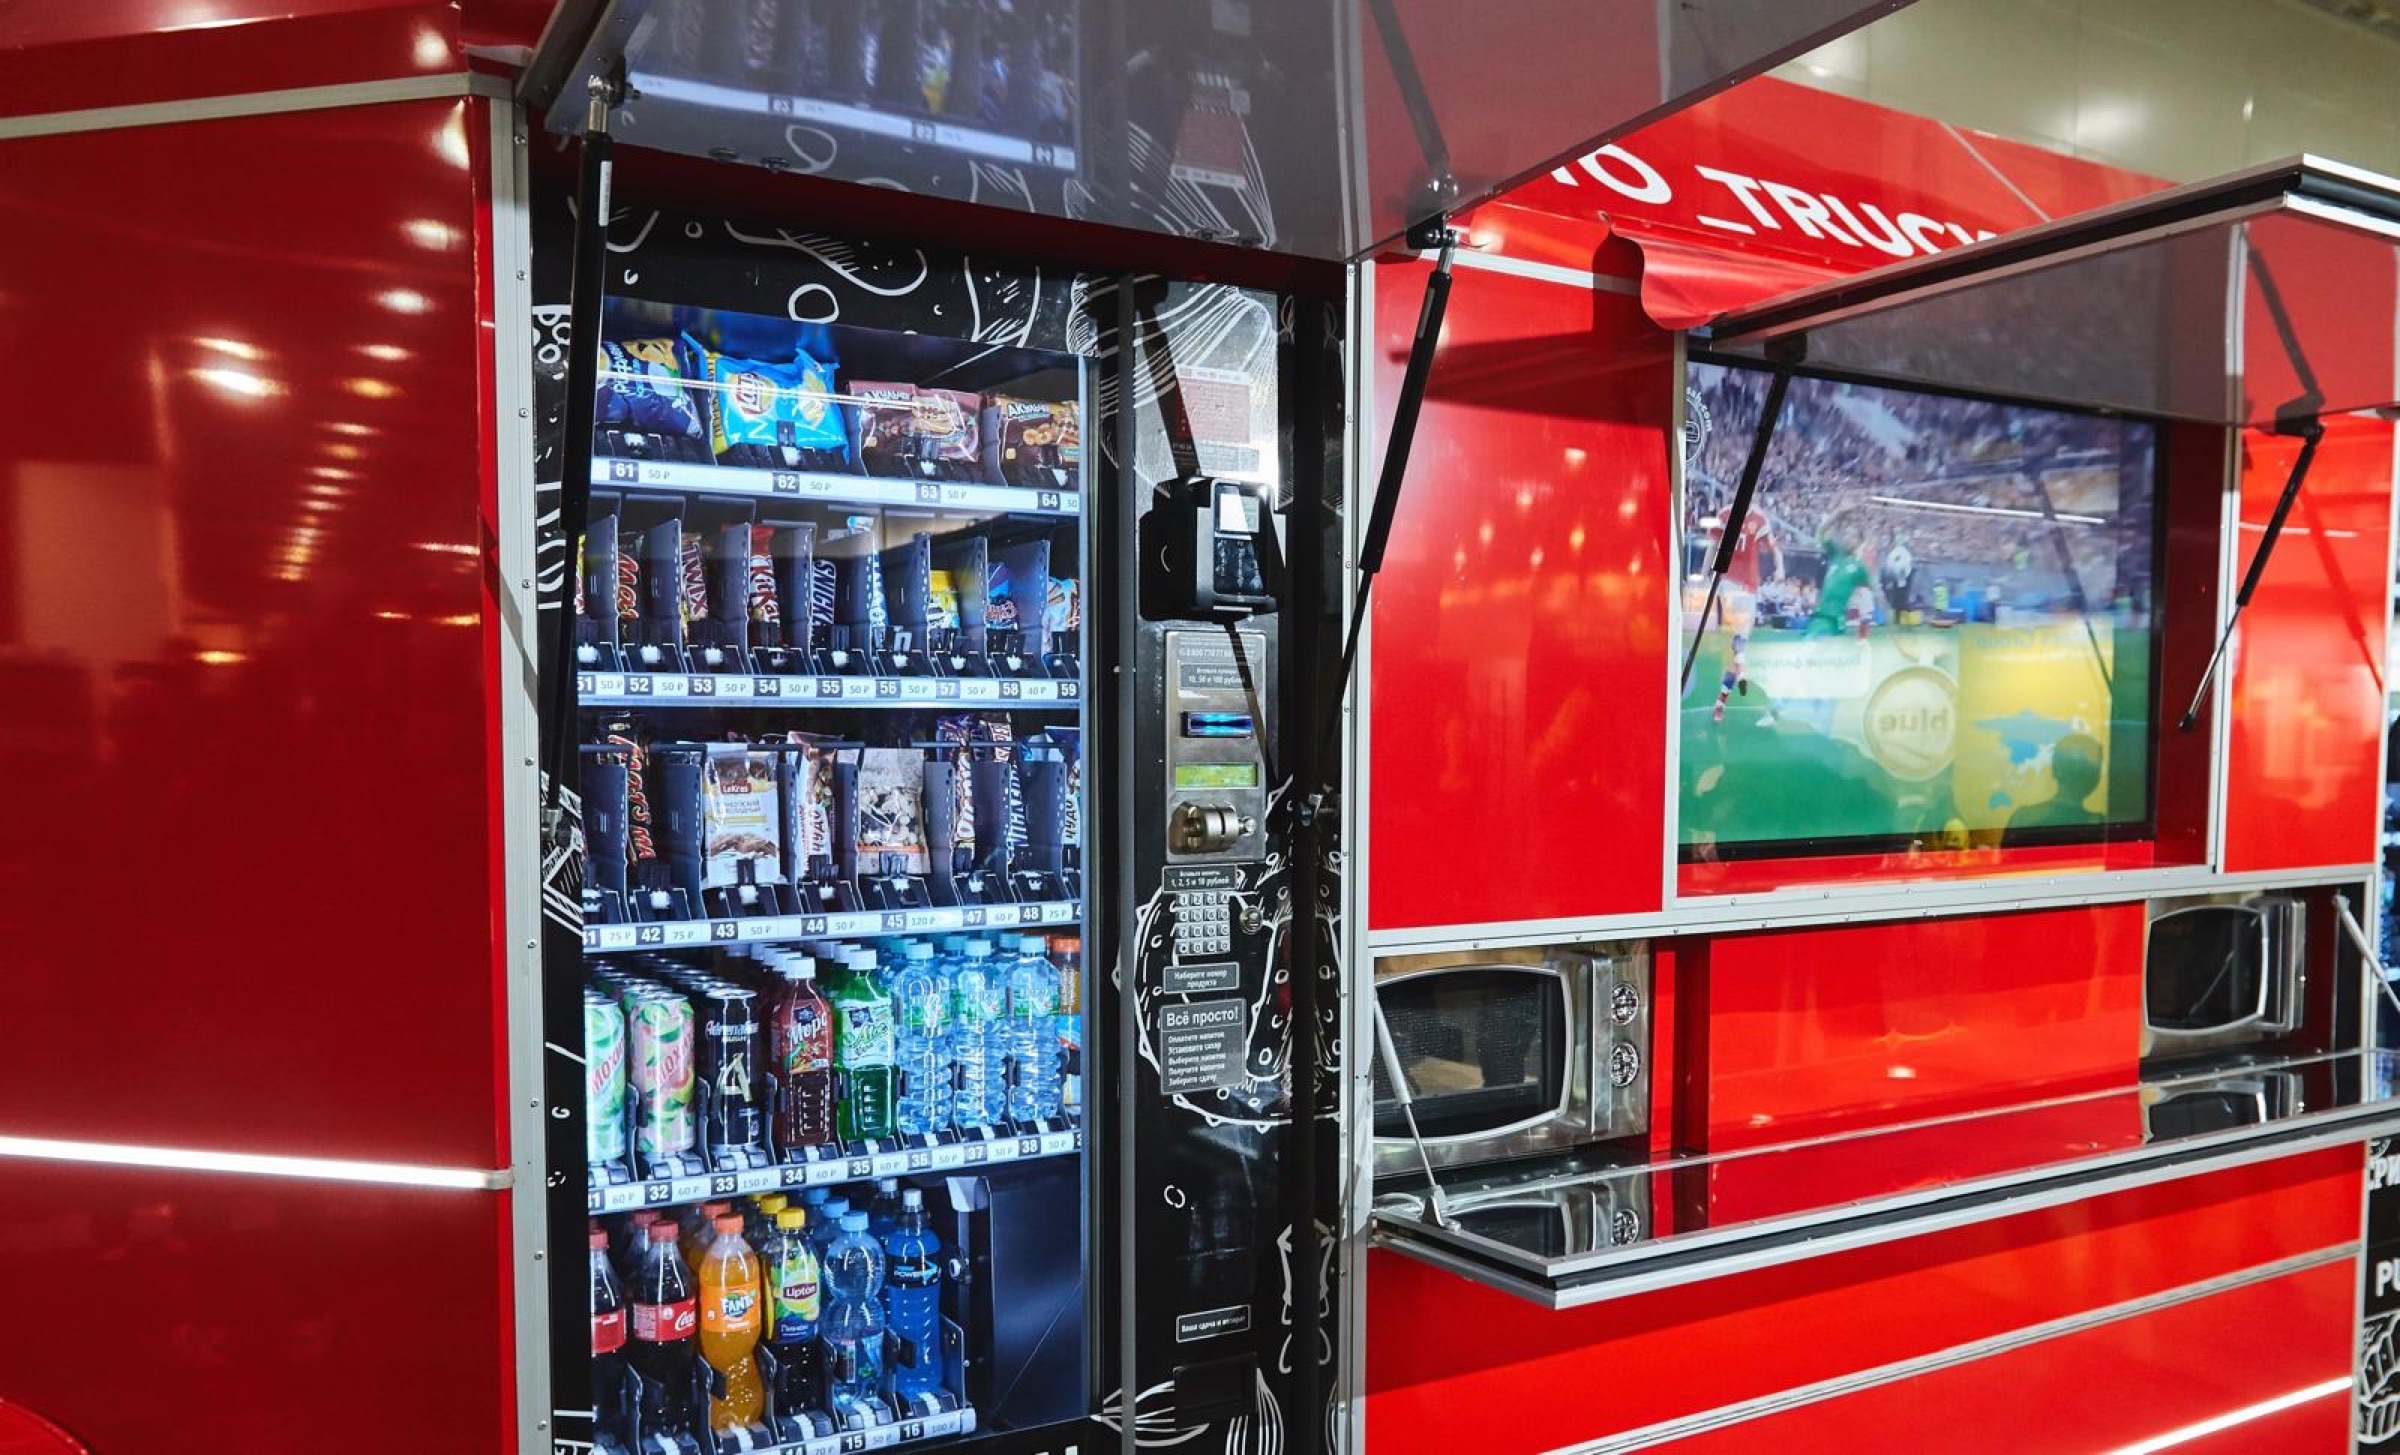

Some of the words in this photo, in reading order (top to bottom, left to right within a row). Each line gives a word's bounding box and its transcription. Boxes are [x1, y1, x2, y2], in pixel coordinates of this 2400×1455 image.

[615, 464, 635, 478] 61
[777, 475, 796, 490] 62
[920, 486, 937, 499] 63
[1041, 493, 1058, 507] 64
[629, 679, 649, 692] 52
[693, 679, 712, 692] 53
[759, 680, 778, 693] 54
[821, 680, 841, 694] 55
[879, 681, 897, 694] 56
[939, 681, 957, 695] 57
[1002, 683, 1019, 696] 58
[1061, 683, 1077, 697] 59
[965, 910, 983, 924] 47
[1022, 906, 1040, 920] 48
[716, 924, 735, 938] 43
[806, 919, 825, 934] 44
[641, 927, 661, 941] 42
[1174, 971, 1205, 980] Наберите
[1166, 1011, 1189, 1026] Всё
[1193, 1006, 1239, 1026] просто!
[1168, 1056, 1200, 1065] Выберите
[1168, 1066, 1198, 1075] Получите
[967, 1146, 984, 1160] 37
[1022, 1139, 1037, 1153] 38
[911, 1153, 928, 1166] 36
[851, 1161, 871, 1174] 35
[785, 1169, 804, 1184] 34
[715, 1176, 735, 1192] 33
[650, 1185, 670, 1200] 32
[786, 1283, 816, 1298] Lipton
[903, 1424, 921, 1438] 16
[845, 1436, 864, 1450] 15
